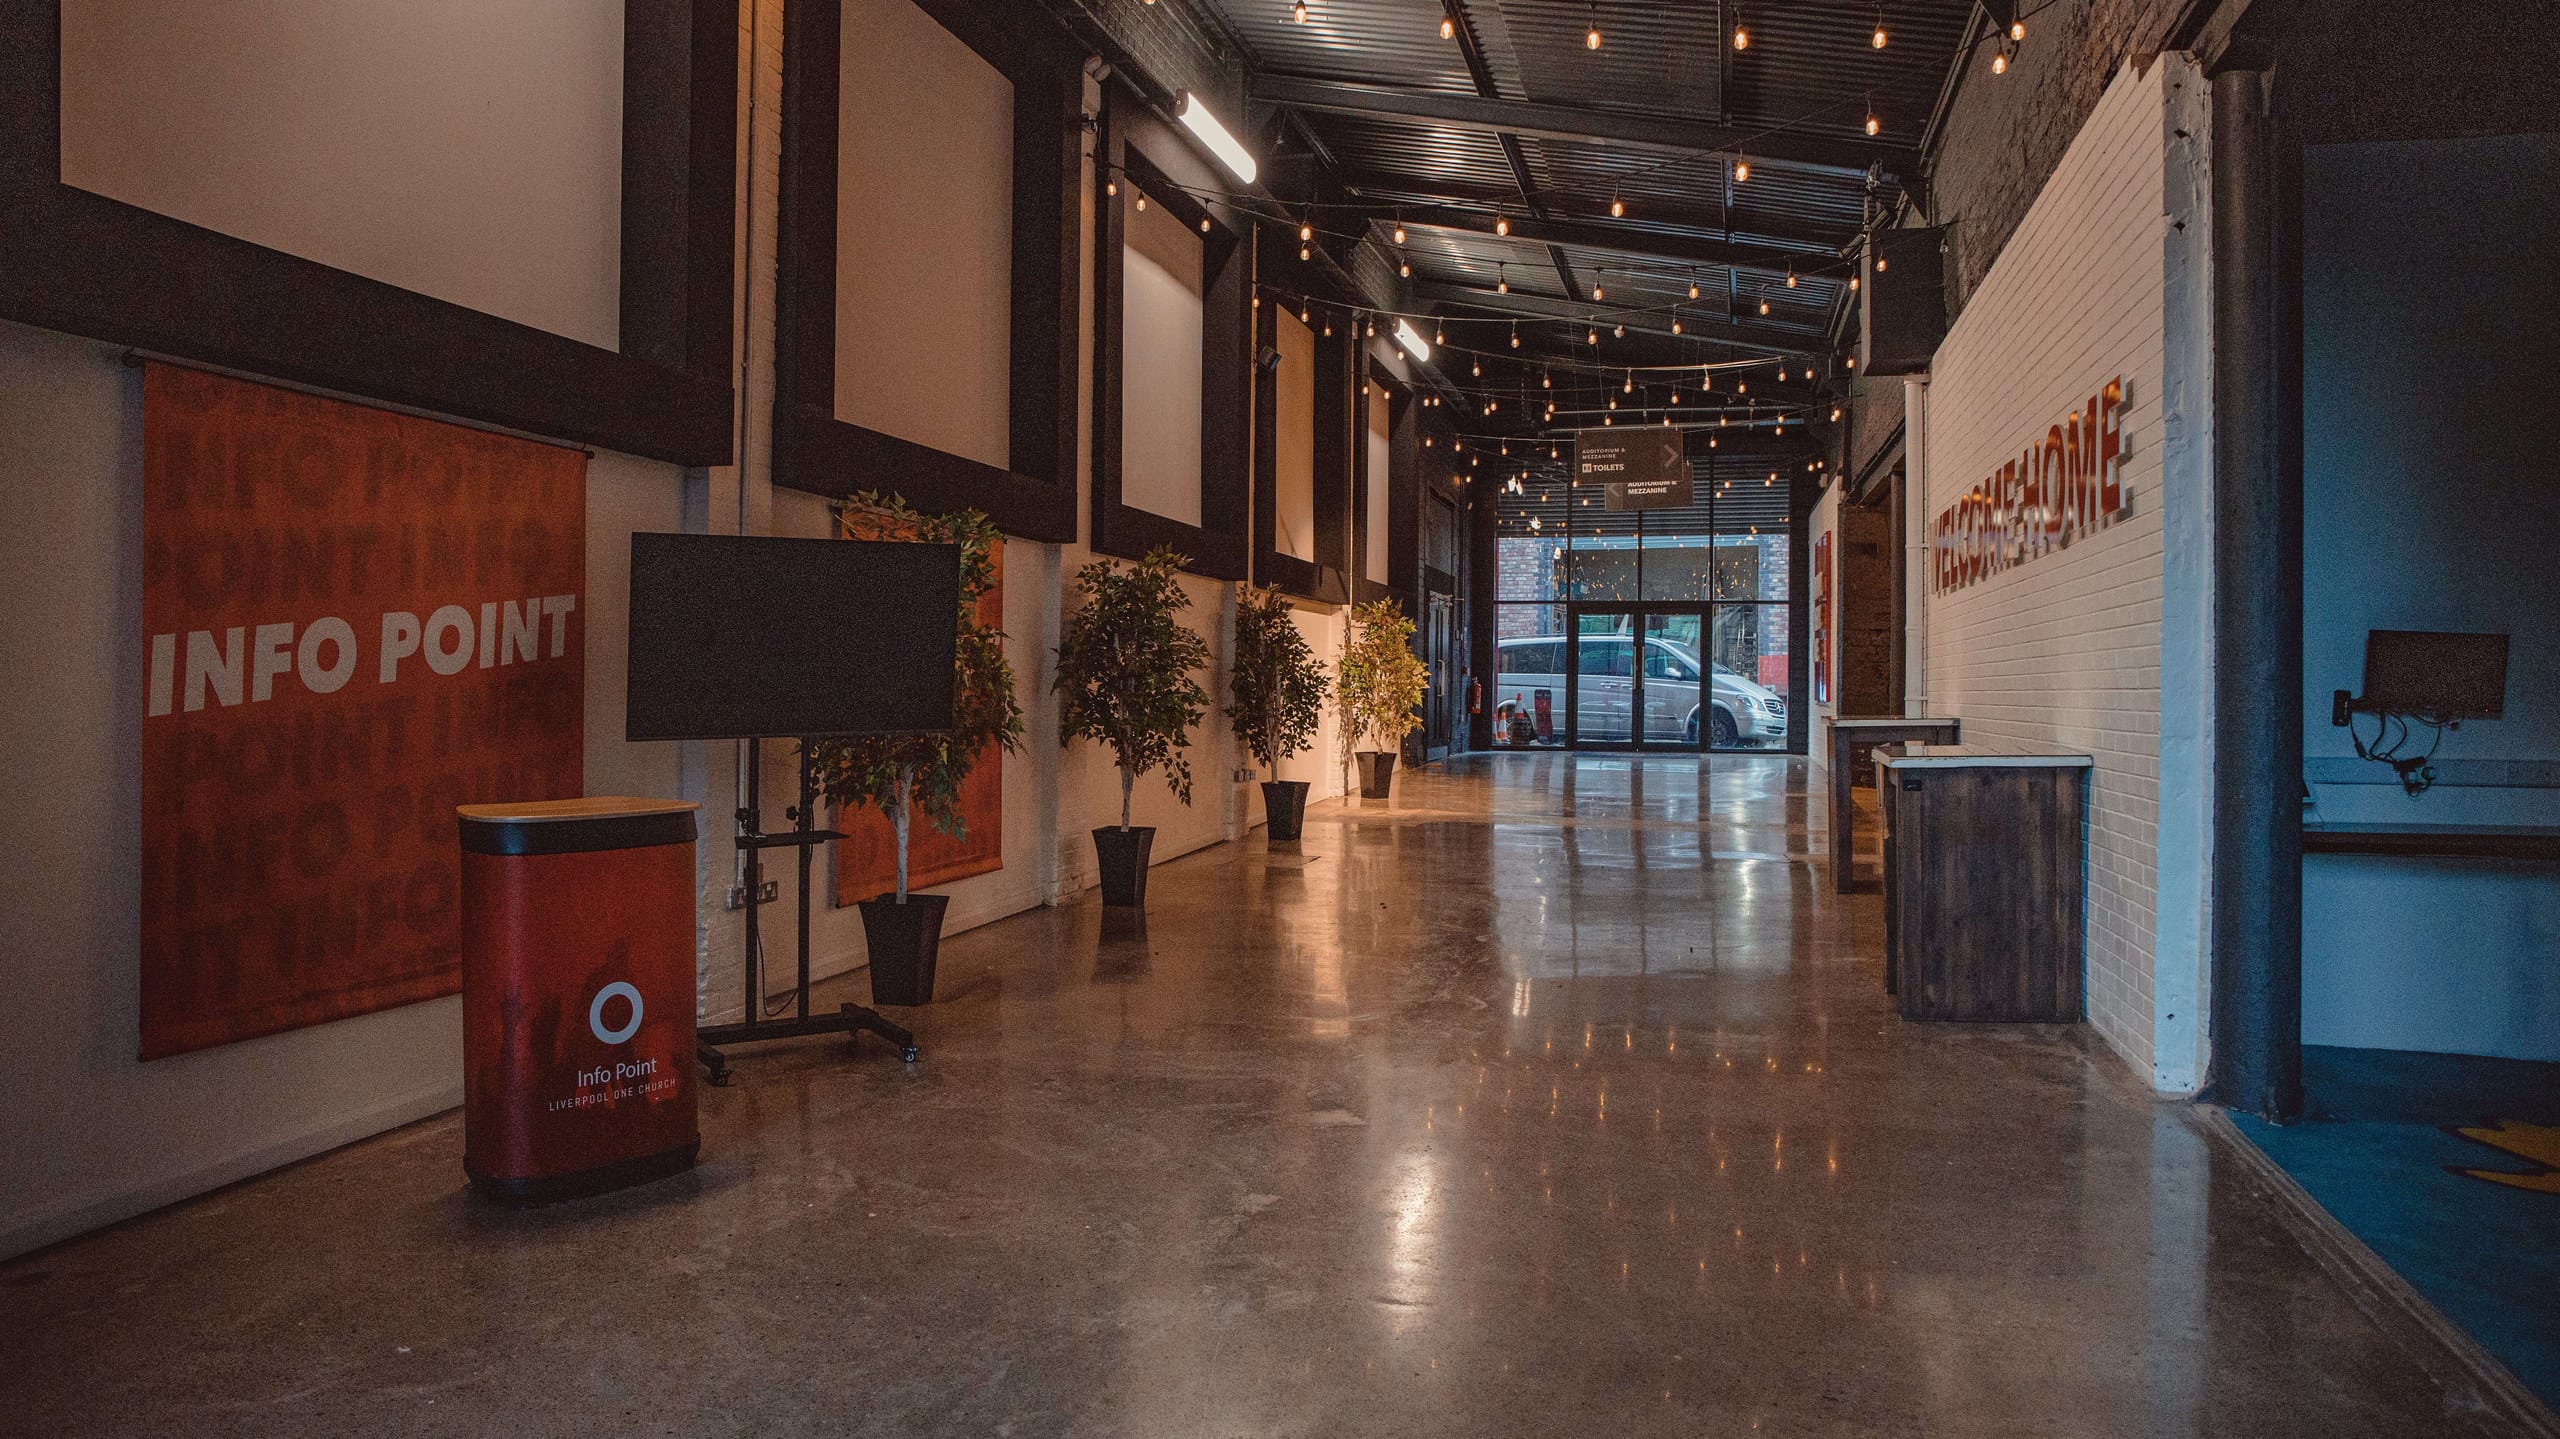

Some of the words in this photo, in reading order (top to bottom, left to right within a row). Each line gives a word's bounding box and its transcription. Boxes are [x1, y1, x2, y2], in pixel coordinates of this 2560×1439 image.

[1593, 463, 1624, 472] TOILETS
[2023, 374, 2126, 553] HOME
[1627, 487, 1667, 495] MEZZANINE
[149, 616, 358, 717] INFO
[379, 594, 576, 684] POINT
[577, 1066, 611, 1088] Info
[616, 1057, 657, 1081] Point
[549, 1093, 609, 1112] LIVERPOOL
[614, 1086, 634, 1100] ONE
[638, 1078, 676, 1095] CHURCH
